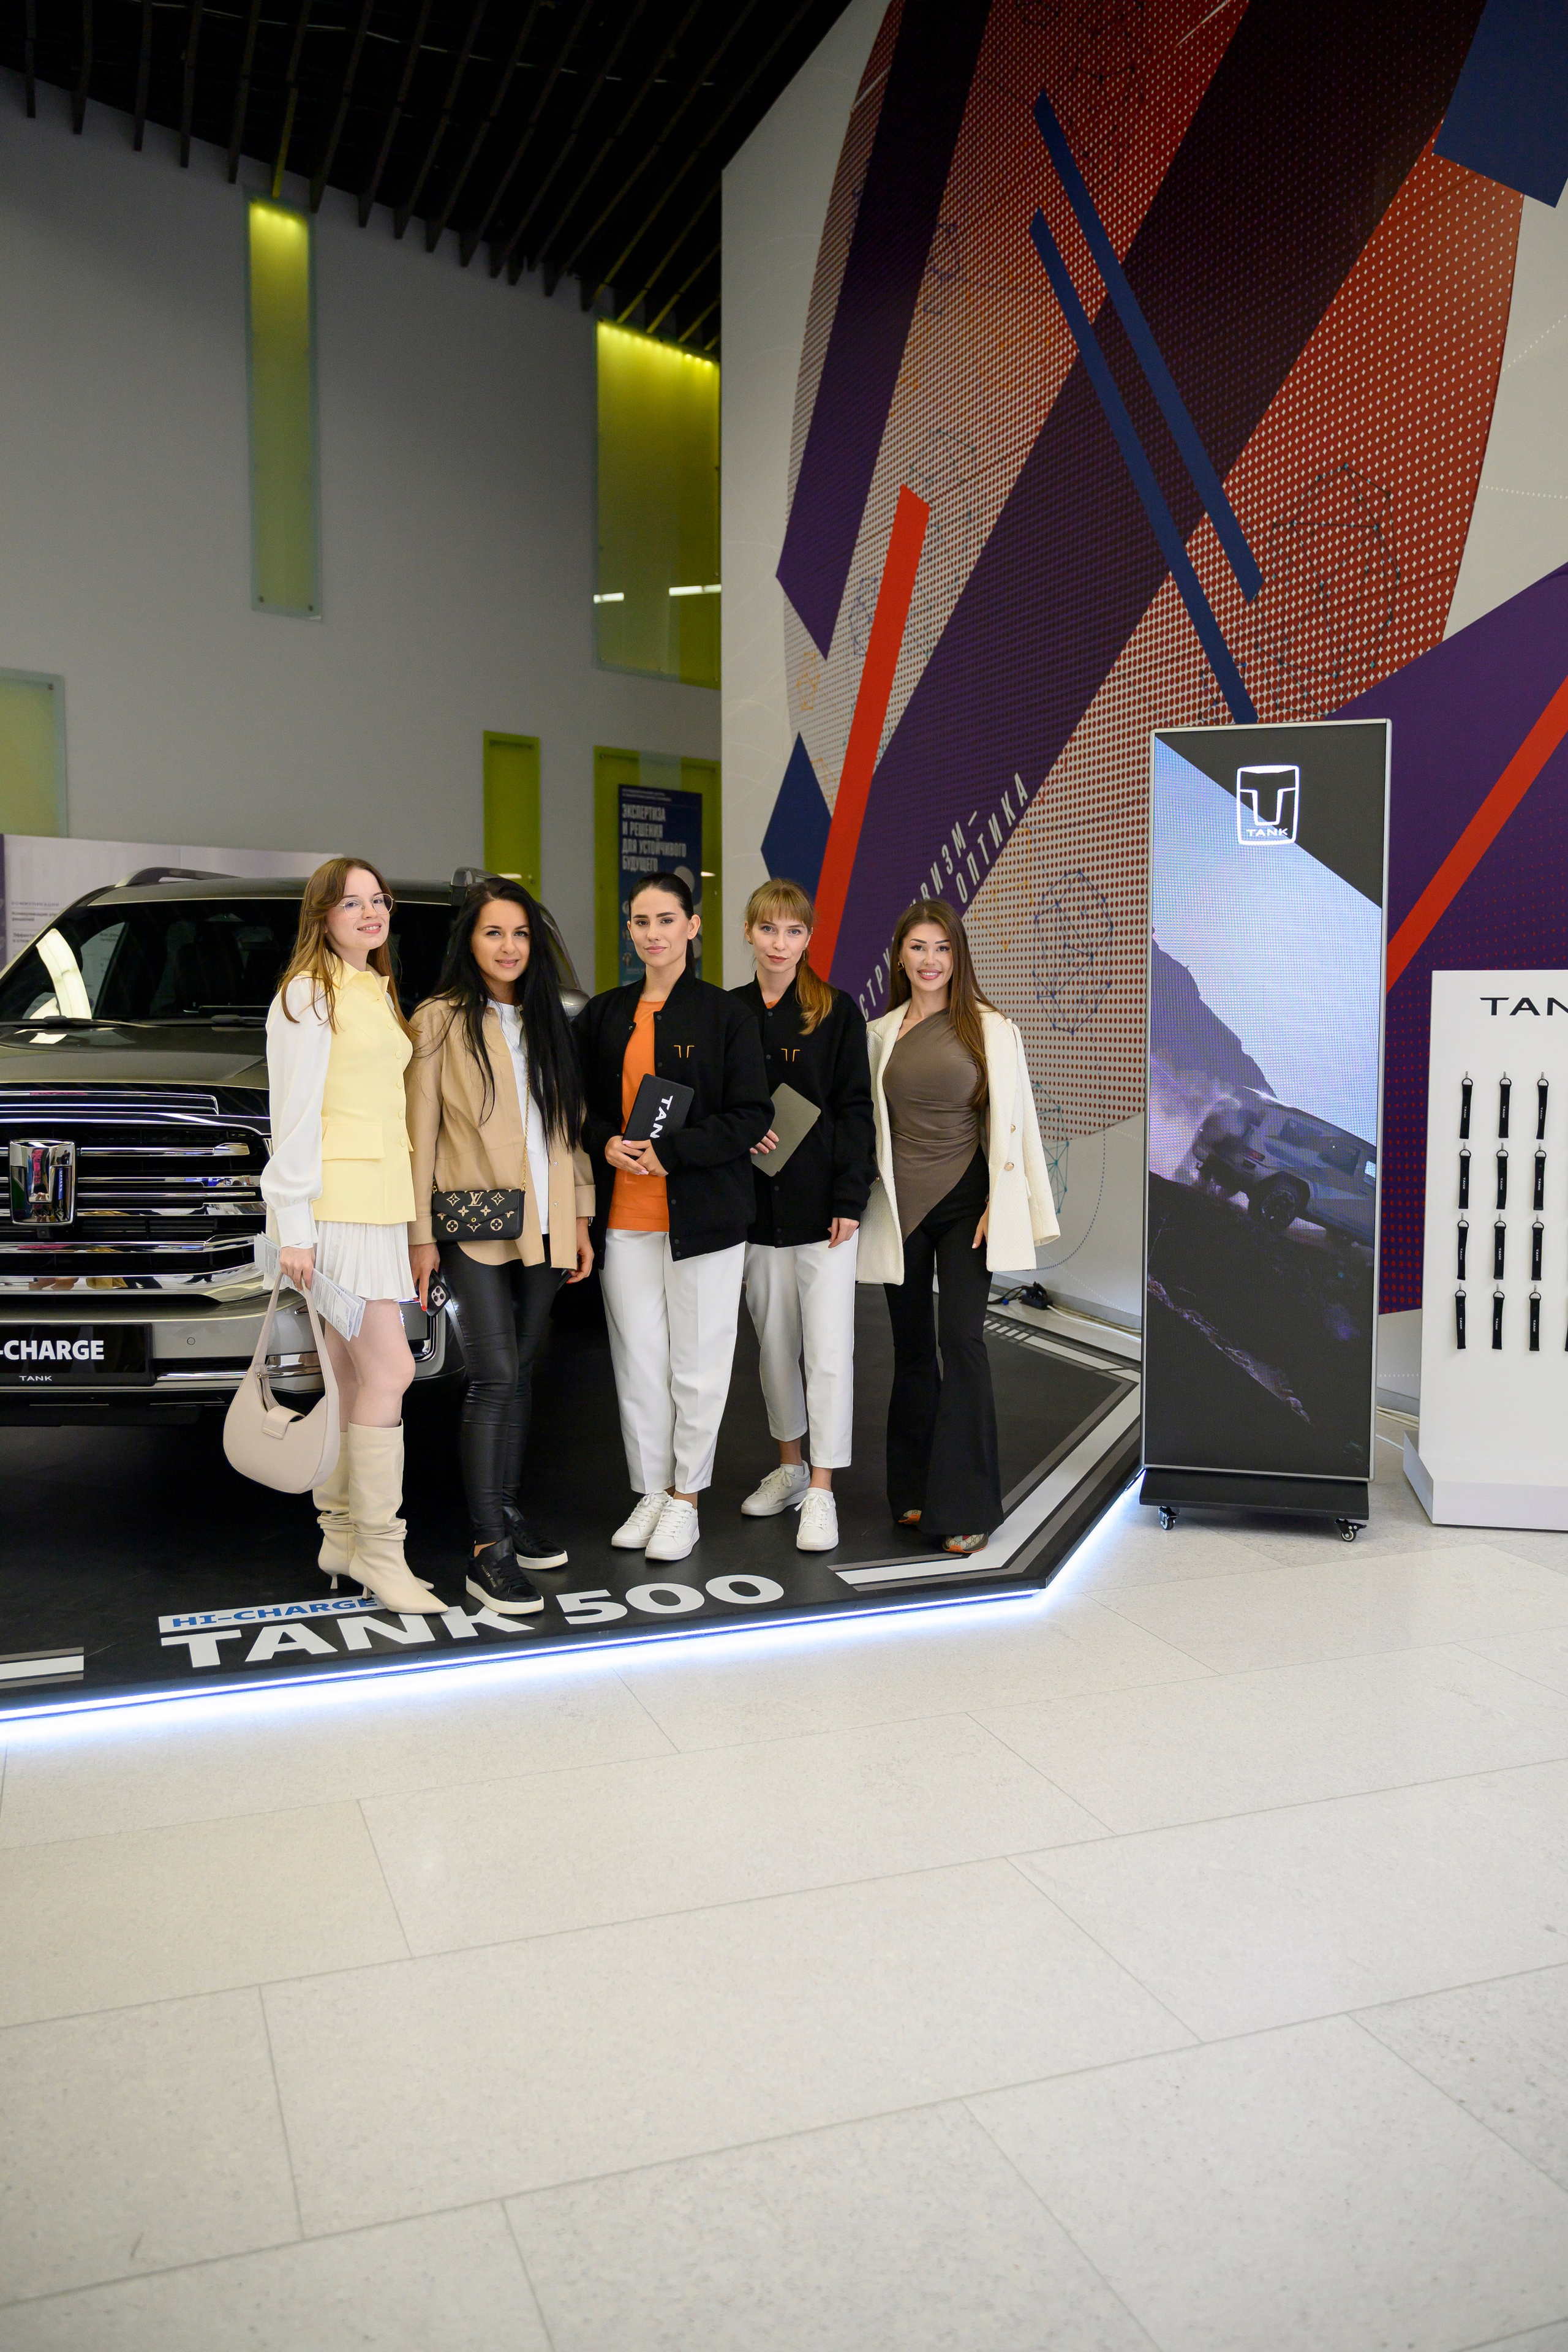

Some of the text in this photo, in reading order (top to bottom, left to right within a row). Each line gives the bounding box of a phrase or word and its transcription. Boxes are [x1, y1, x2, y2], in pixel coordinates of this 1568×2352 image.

[622, 803, 666, 822] ЭКСПЕРТИЗА
[622, 821, 663, 839] И РЕШЕНИЯ
[956, 772, 1028, 904] ОПТИКА
[1246, 828, 1288, 837] TANK
[622, 838, 687, 858] ДЛЯ УСТОЙЧИВОГО
[622, 856, 658, 873] БУДУЩЕГО
[650, 1095, 674, 1139] TAN
[161, 1574, 784, 1668] TANK 500
[173, 1597, 378, 1628] HI-CHARGE
